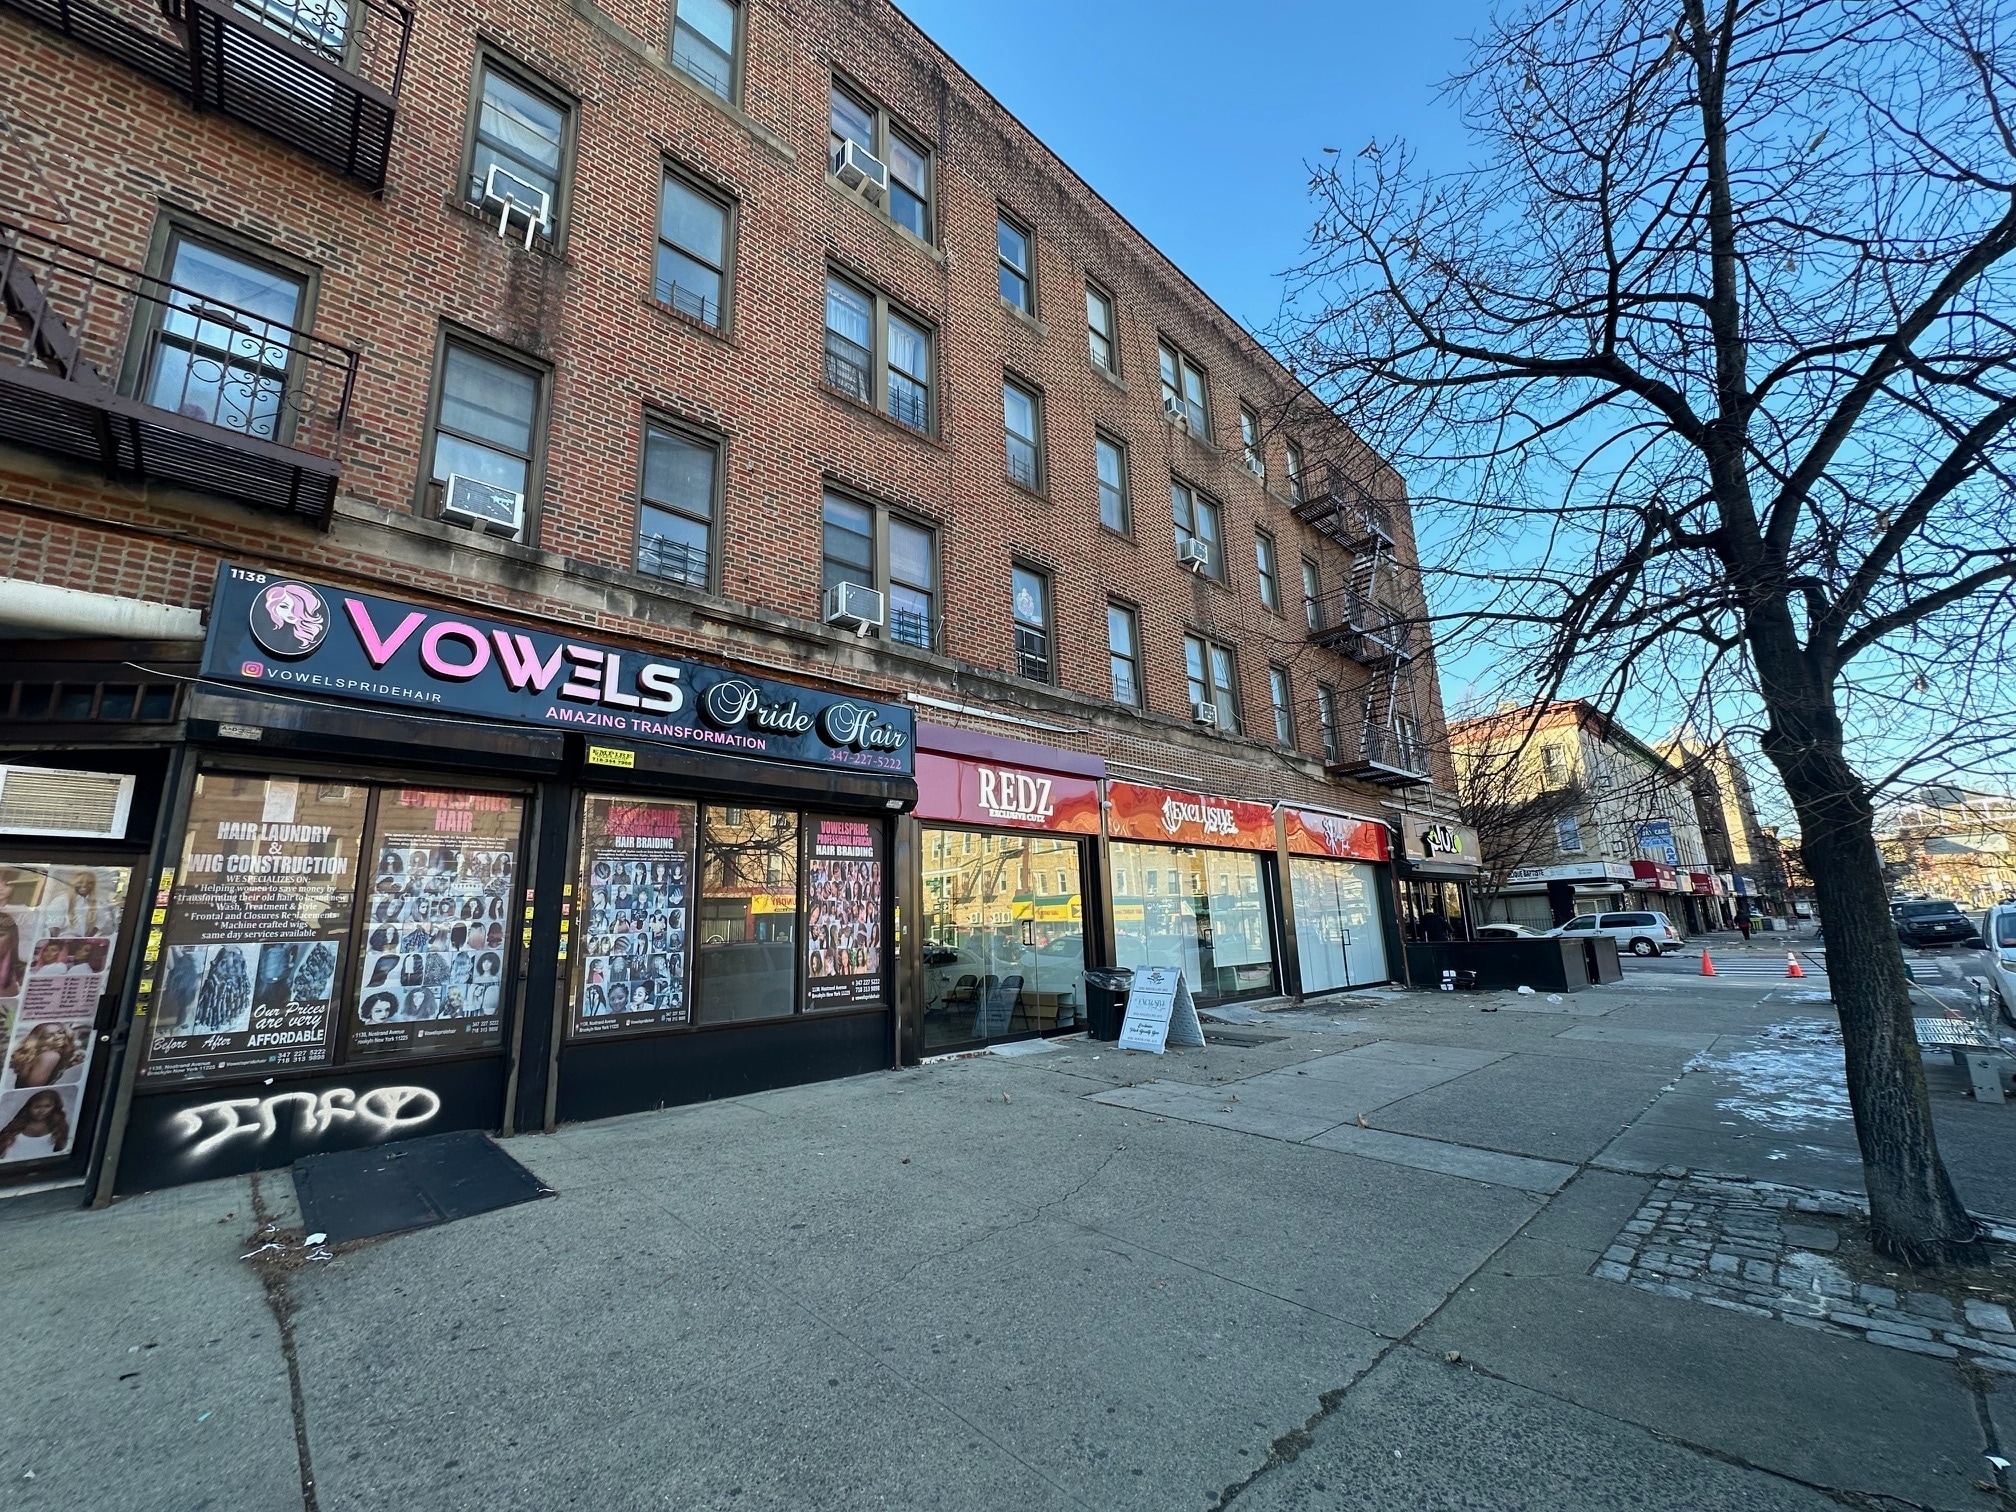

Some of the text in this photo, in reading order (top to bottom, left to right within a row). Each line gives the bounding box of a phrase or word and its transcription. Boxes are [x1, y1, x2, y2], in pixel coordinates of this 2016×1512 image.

[230, 568, 266, 584] 1138
[343, 597, 684, 713] VOWELS
[267, 668, 441, 702] VOWELSPRIDEHAIR
[707, 680, 907, 749] Pride Hair
[546, 706, 766, 750] AMAZING TRANSFORMATION
[829, 749, 902, 770] 347-227-5222
[978, 768, 1054, 816] REDZ
[435, 810, 474, 832] HAIR
[821, 821, 868, 836] VOWELSPRIDE
[218, 822, 331, 843] HAIR LAUNDRY
[269, 842, 282, 855] &
[616, 836, 674, 849] HAIR BRAIDING
[816, 845, 874, 857] HAIR BRAIDING
[188, 854, 348, 874] WIG CONSTRUCTION
[200, 884, 234, 893] Helping
[326, 884, 337, 893] by
[216, 903, 242, 911] Wash,
[297, 903, 318, 912] Style
[290, 921, 308, 930] wigs
[226, 931, 243, 940] day
[244, 931, 279, 939] services
[254, 1002, 326, 1017] Our Prices
[256, 1016, 322, 1031] are very
[153, 1035, 231, 1054] Before After
[247, 1029, 324, 1047] AFFORDABLE
